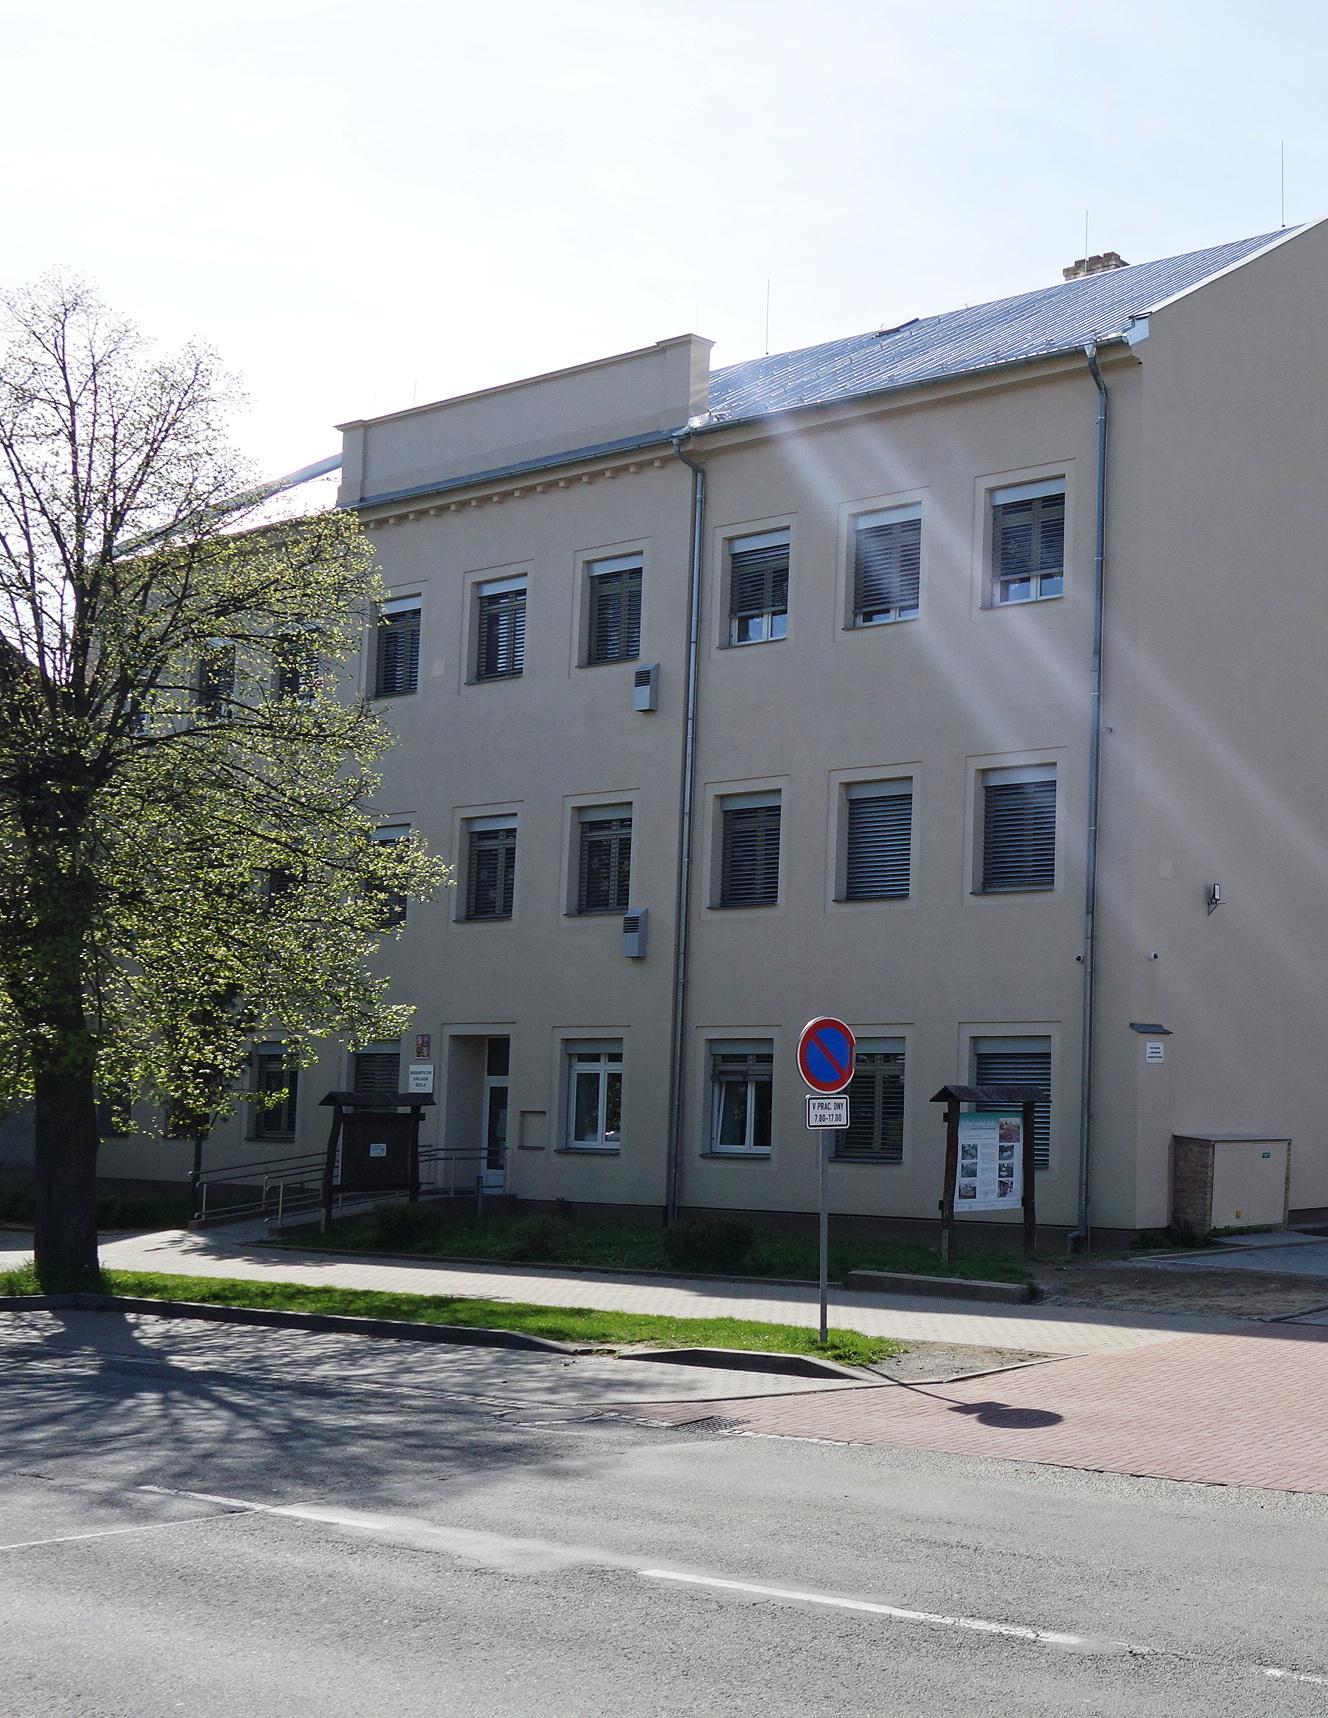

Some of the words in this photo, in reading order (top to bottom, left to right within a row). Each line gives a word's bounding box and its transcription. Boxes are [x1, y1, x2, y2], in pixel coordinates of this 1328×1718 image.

[812, 1102, 817, 1111] V
[817, 1102, 832, 1111] PRAC.
[833, 1102, 844, 1111] DNY
